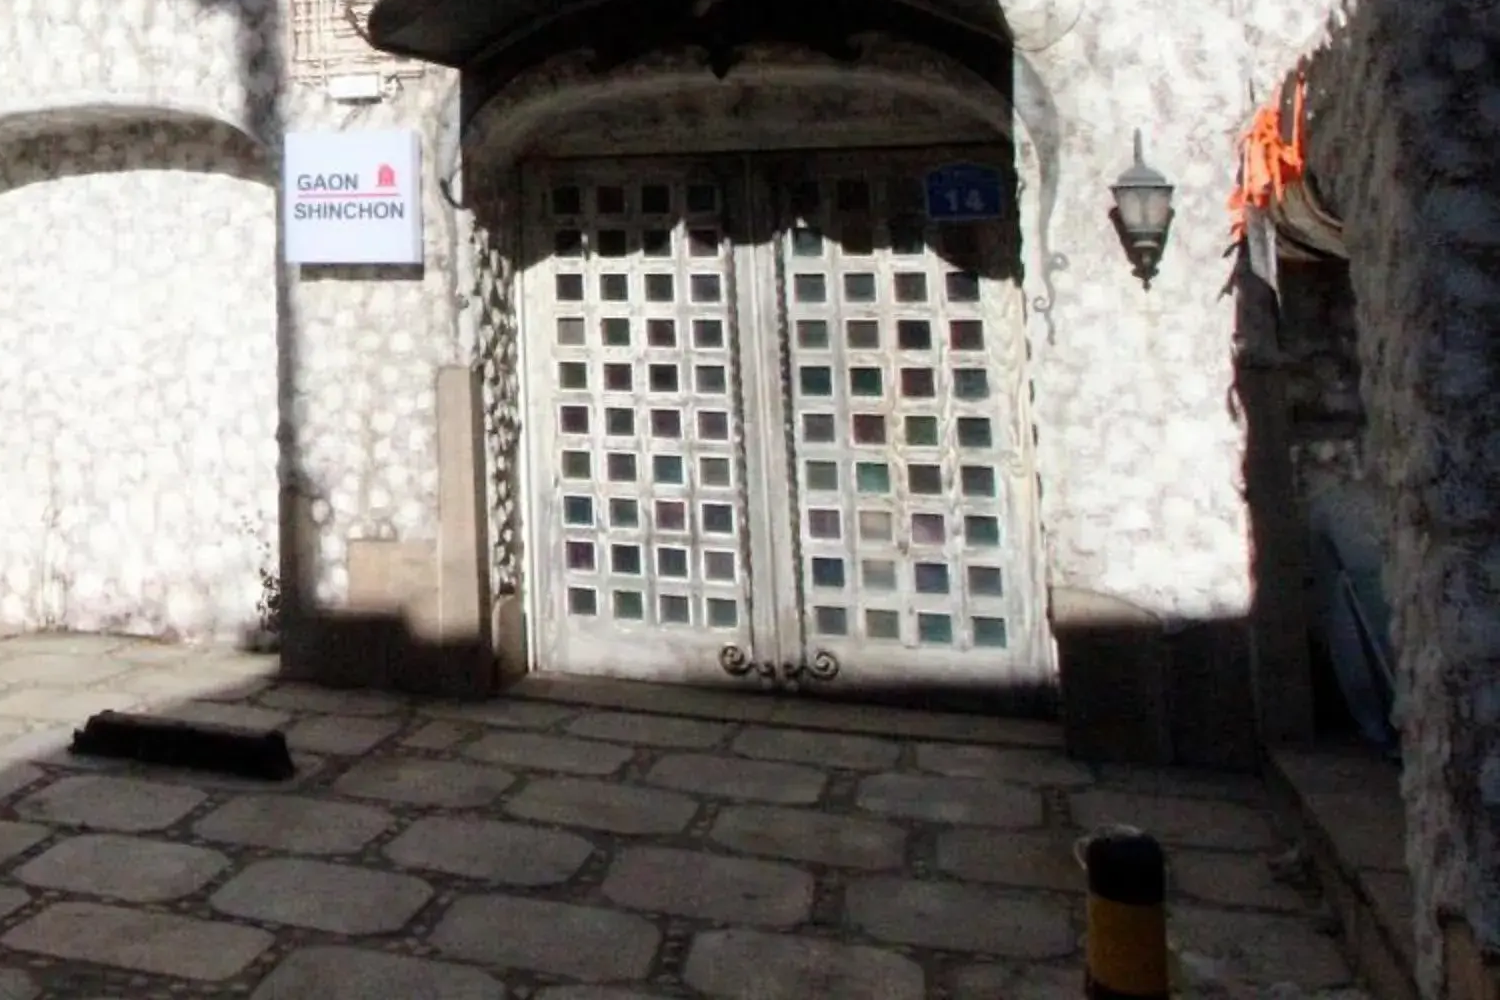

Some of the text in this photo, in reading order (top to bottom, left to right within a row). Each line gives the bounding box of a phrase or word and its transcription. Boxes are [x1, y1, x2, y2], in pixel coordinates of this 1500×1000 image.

[297, 174, 359, 191] GAON
[944, 189, 985, 212] 14
[294, 202, 404, 219] SHINCHON
